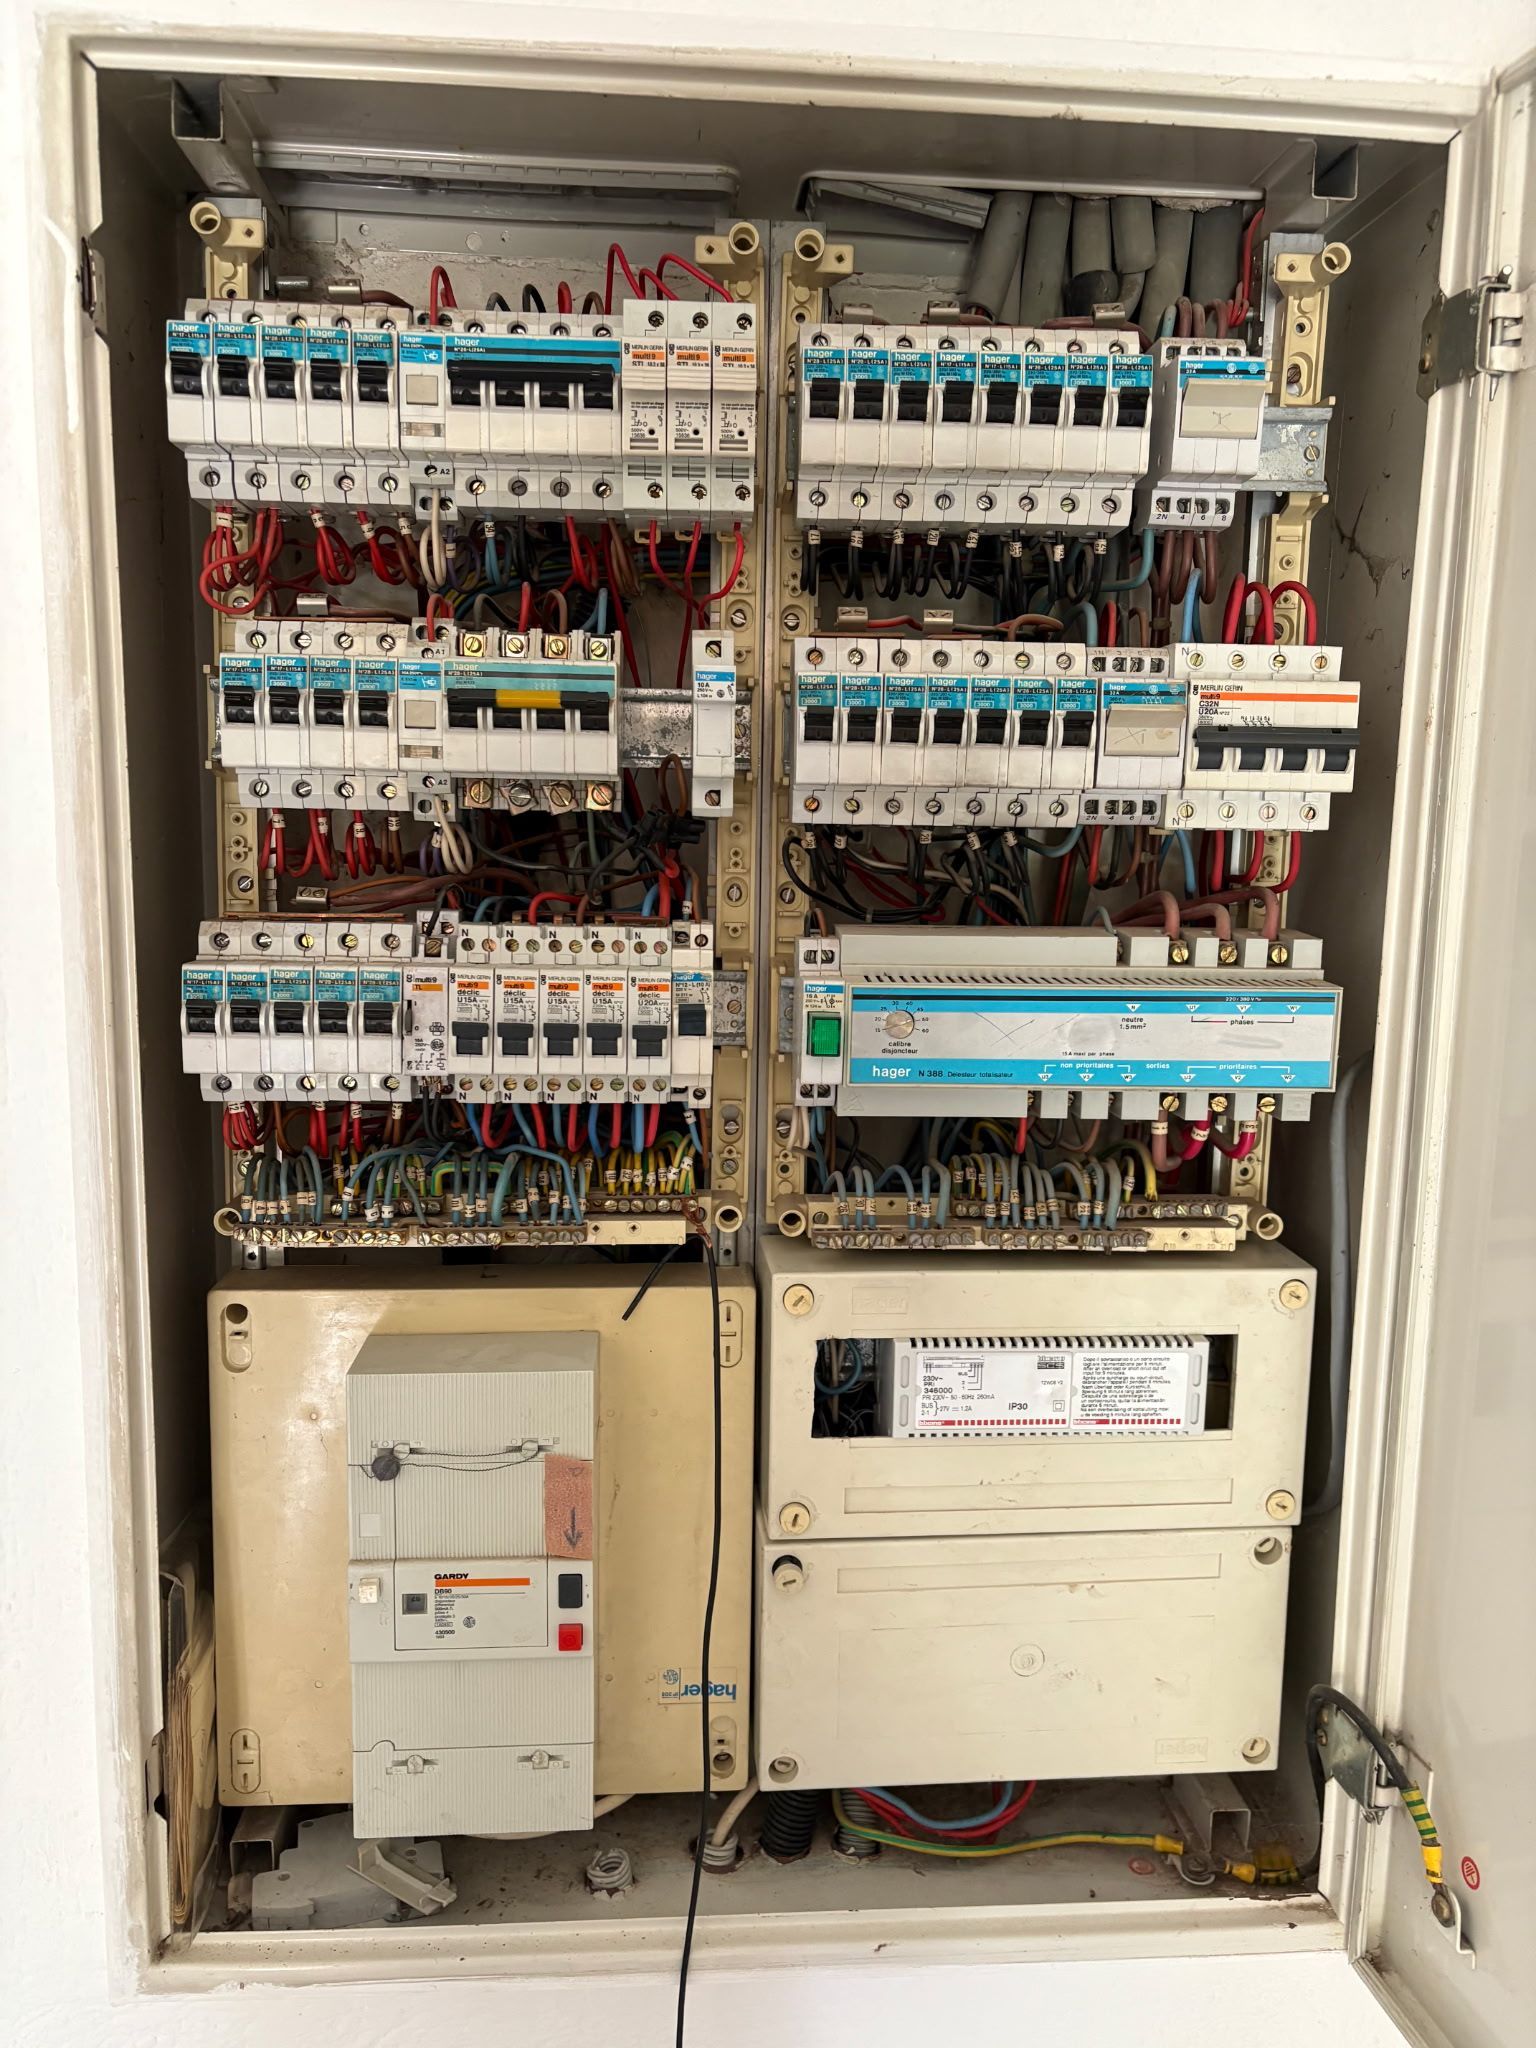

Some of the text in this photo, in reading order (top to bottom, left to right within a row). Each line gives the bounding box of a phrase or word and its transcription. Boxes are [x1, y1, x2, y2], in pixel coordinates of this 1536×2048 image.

[172, 323, 200, 333] hager
[218, 323, 245, 333] hager
[265, 326, 291, 335] hager
[310, 328, 336, 338] hager
[357, 333, 383, 342] hager
[454, 337, 480, 346] hager
[808, 349, 834, 359] hager
[851, 350, 877, 359] hager
[895, 352, 922, 362] hager
[940, 352, 966, 362] hager
[984, 354, 1011, 364] hager
[1029, 355, 1055, 365] hager
[1072, 355, 1097, 365] hager
[1116, 355, 1142, 365] hager
[1182, 647, 1190, 656] N
[225, 658, 251, 667] hager
[270, 657, 297, 666] hager
[314, 658, 340, 668] hager
[359, 660, 384, 669] hager
[453, 663, 479, 671] hager
[801, 675, 827, 684] hager
[845, 677, 871, 685] hager
[890, 677, 915, 686] hager
[932, 678, 957, 686] hager
[975, 678, 1000, 687] hager
[1018, 679, 1043, 688] hager
[1061, 679, 1086, 688] hager
[1200, 684, 1223, 692] MERLIN
[1172, 818, 1180, 826] N
[461, 928, 469, 937] N
[506, 929, 514, 938] N
[549, 930, 557, 939] N
[591, 930, 599, 939] N
[187, 970, 212, 979] hager
[231, 973, 257, 981] hager
[274, 969, 299, 979] hager
[320, 970, 345, 979] hager
[364, 971, 389, 980] hager
[807, 985, 828, 993] hager
[1230, 1018, 1254, 1026] phases
[872, 1065, 912, 1079] hager
[927, 1070, 944, 1078] 388
[459, 1092, 467, 1100] N
[504, 1093, 512, 1101] N
[547, 1093, 555, 1101] N
[590, 1092, 598, 1100] N
[634, 1094, 640, 1102] N
[1009, 1402, 1028, 1410] IP30
